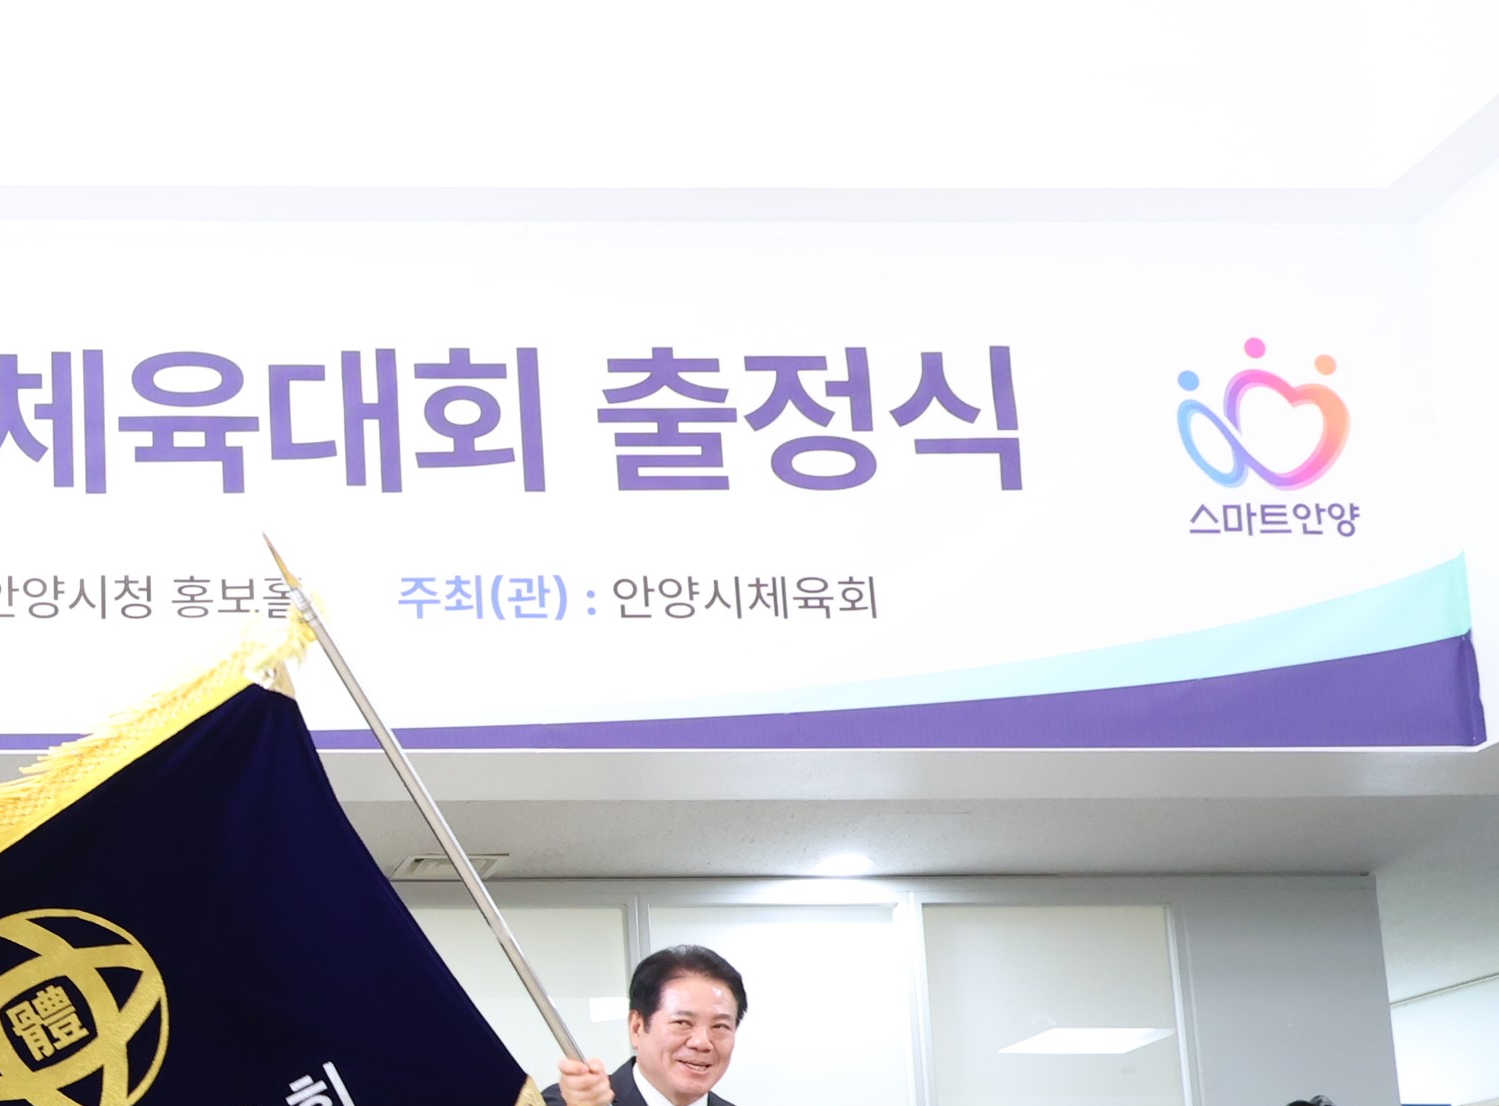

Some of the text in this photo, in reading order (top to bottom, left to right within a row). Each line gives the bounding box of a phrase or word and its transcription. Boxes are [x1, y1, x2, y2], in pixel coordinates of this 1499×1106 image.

[597, 345, 1023, 491] 출정식
[1189, 502, 1361, 538] 스마트안양
[398, 574, 568, 621] 주최(관)
[612, 575, 878, 620] 안양시체육회
